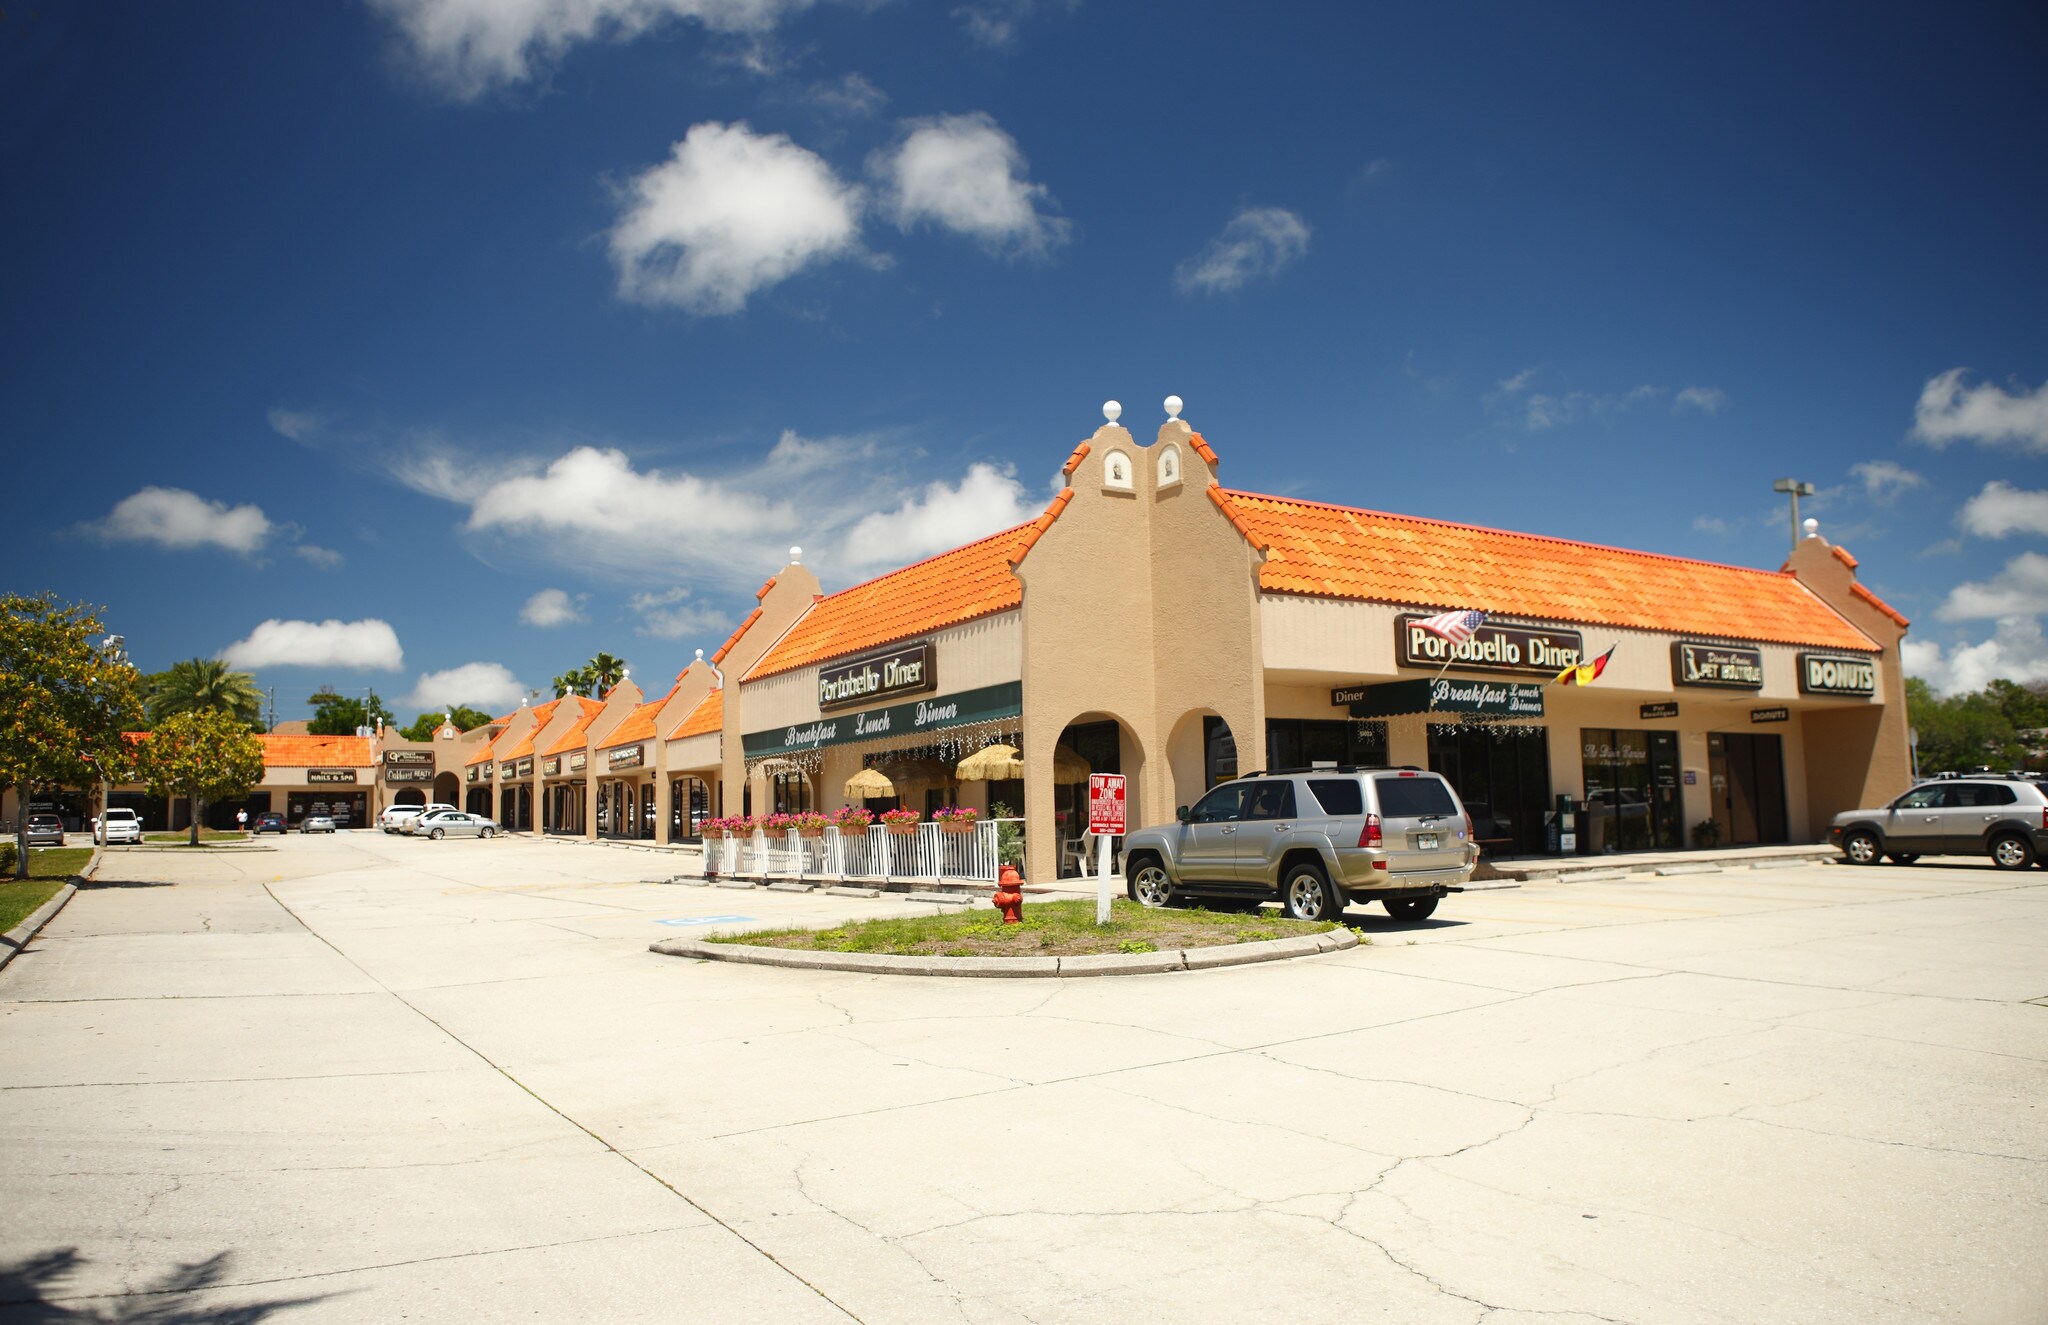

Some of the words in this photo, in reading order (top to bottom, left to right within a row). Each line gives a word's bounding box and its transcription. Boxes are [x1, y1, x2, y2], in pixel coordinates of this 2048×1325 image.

[1529, 637, 1579, 667] Diner
[820, 665, 880, 703] Portobello
[884, 657, 923, 688] Diner
[1810, 659, 1873, 689] DONUTS
[1335, 690, 1364, 703] Diner
[1432, 680, 1507, 708] Breakfast
[1509, 683, 1540, 698] Lunch
[1508, 698, 1542, 713] Dinner
[784, 722, 837, 747] Breakfast
[855, 710, 891, 736] Lunch
[914, 700, 958, 727] Dinner
[1092, 777, 1105, 788] TOW
[1107, 777, 1124, 789] AWAY
[1099, 788, 1117, 800] ZONE
